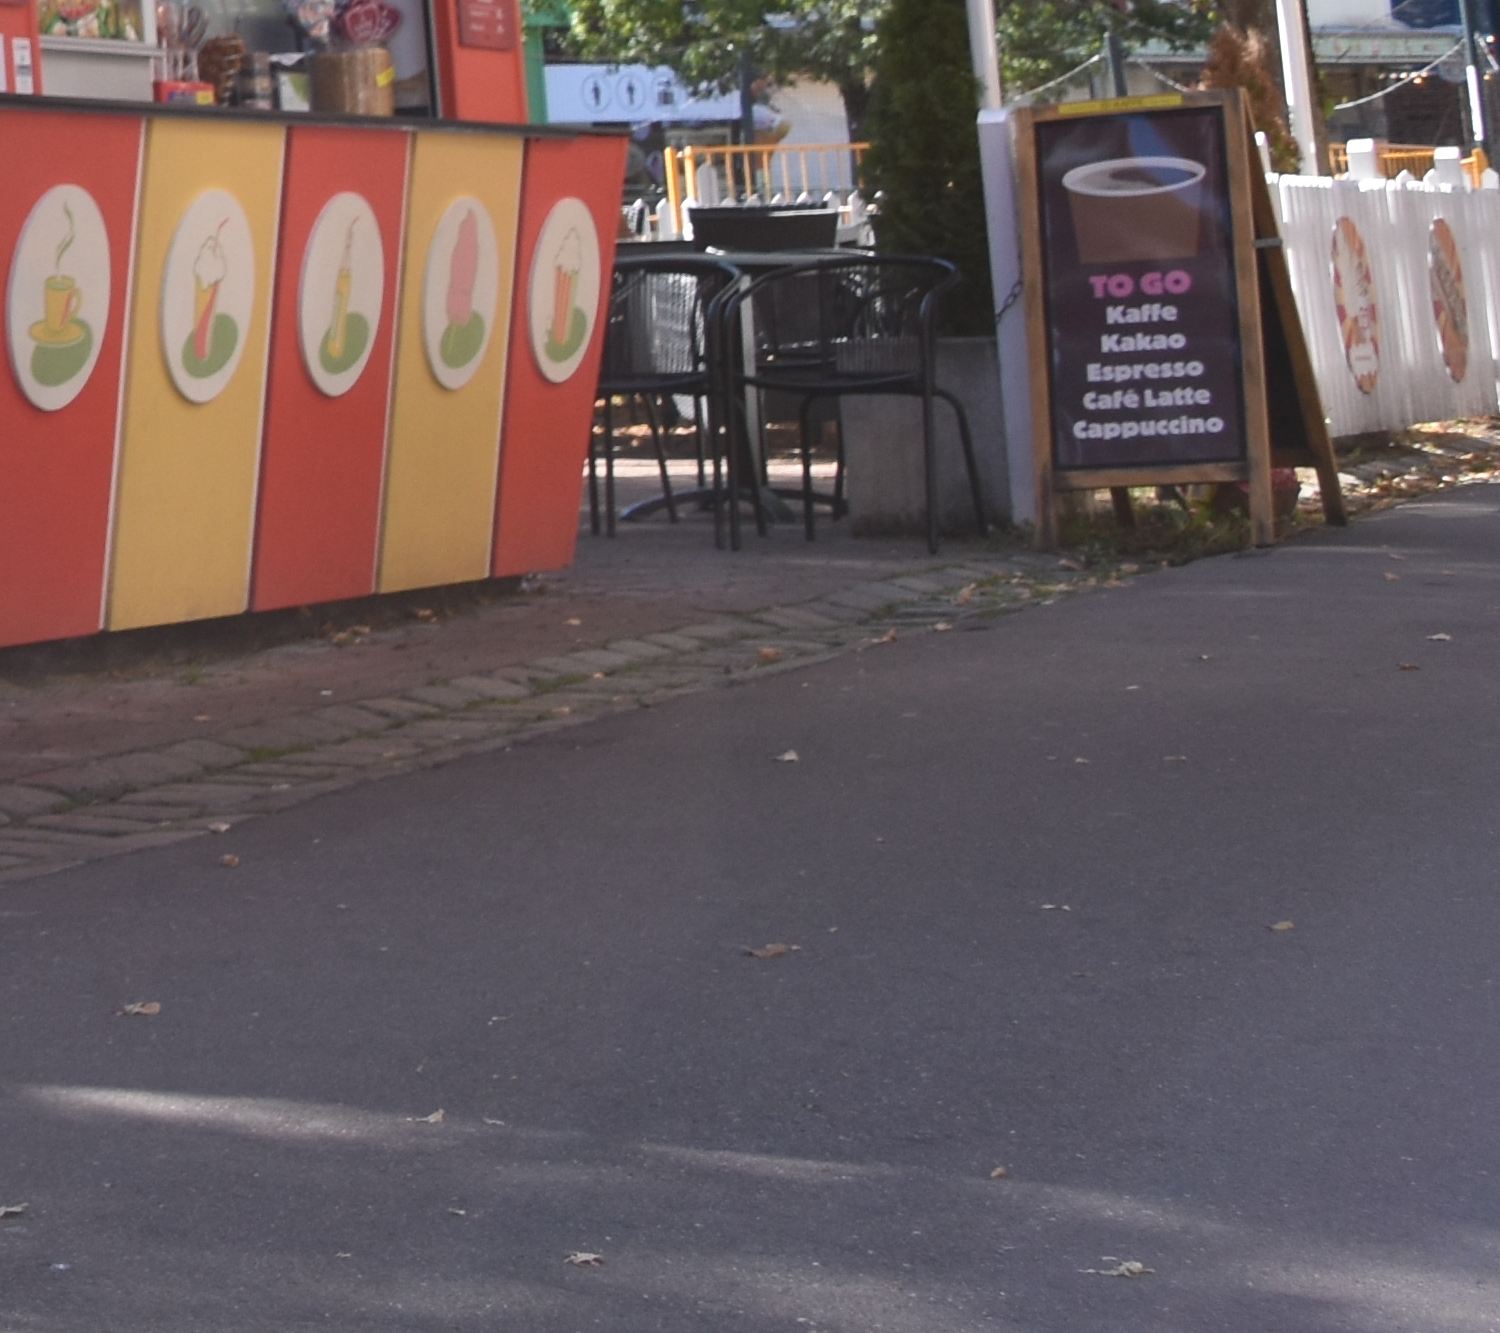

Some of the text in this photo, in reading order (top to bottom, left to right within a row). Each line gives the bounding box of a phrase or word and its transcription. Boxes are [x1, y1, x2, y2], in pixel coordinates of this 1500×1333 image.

[1089, 270, 1192, 299] TO GO
[1106, 302, 1178, 324] Kaffe
[1101, 330, 1186, 353] Kakao
[1086, 359, 1204, 383] Espresso
[1083, 386, 1211, 410] Café Latte
[1073, 415, 1224, 440] Cappuccino
